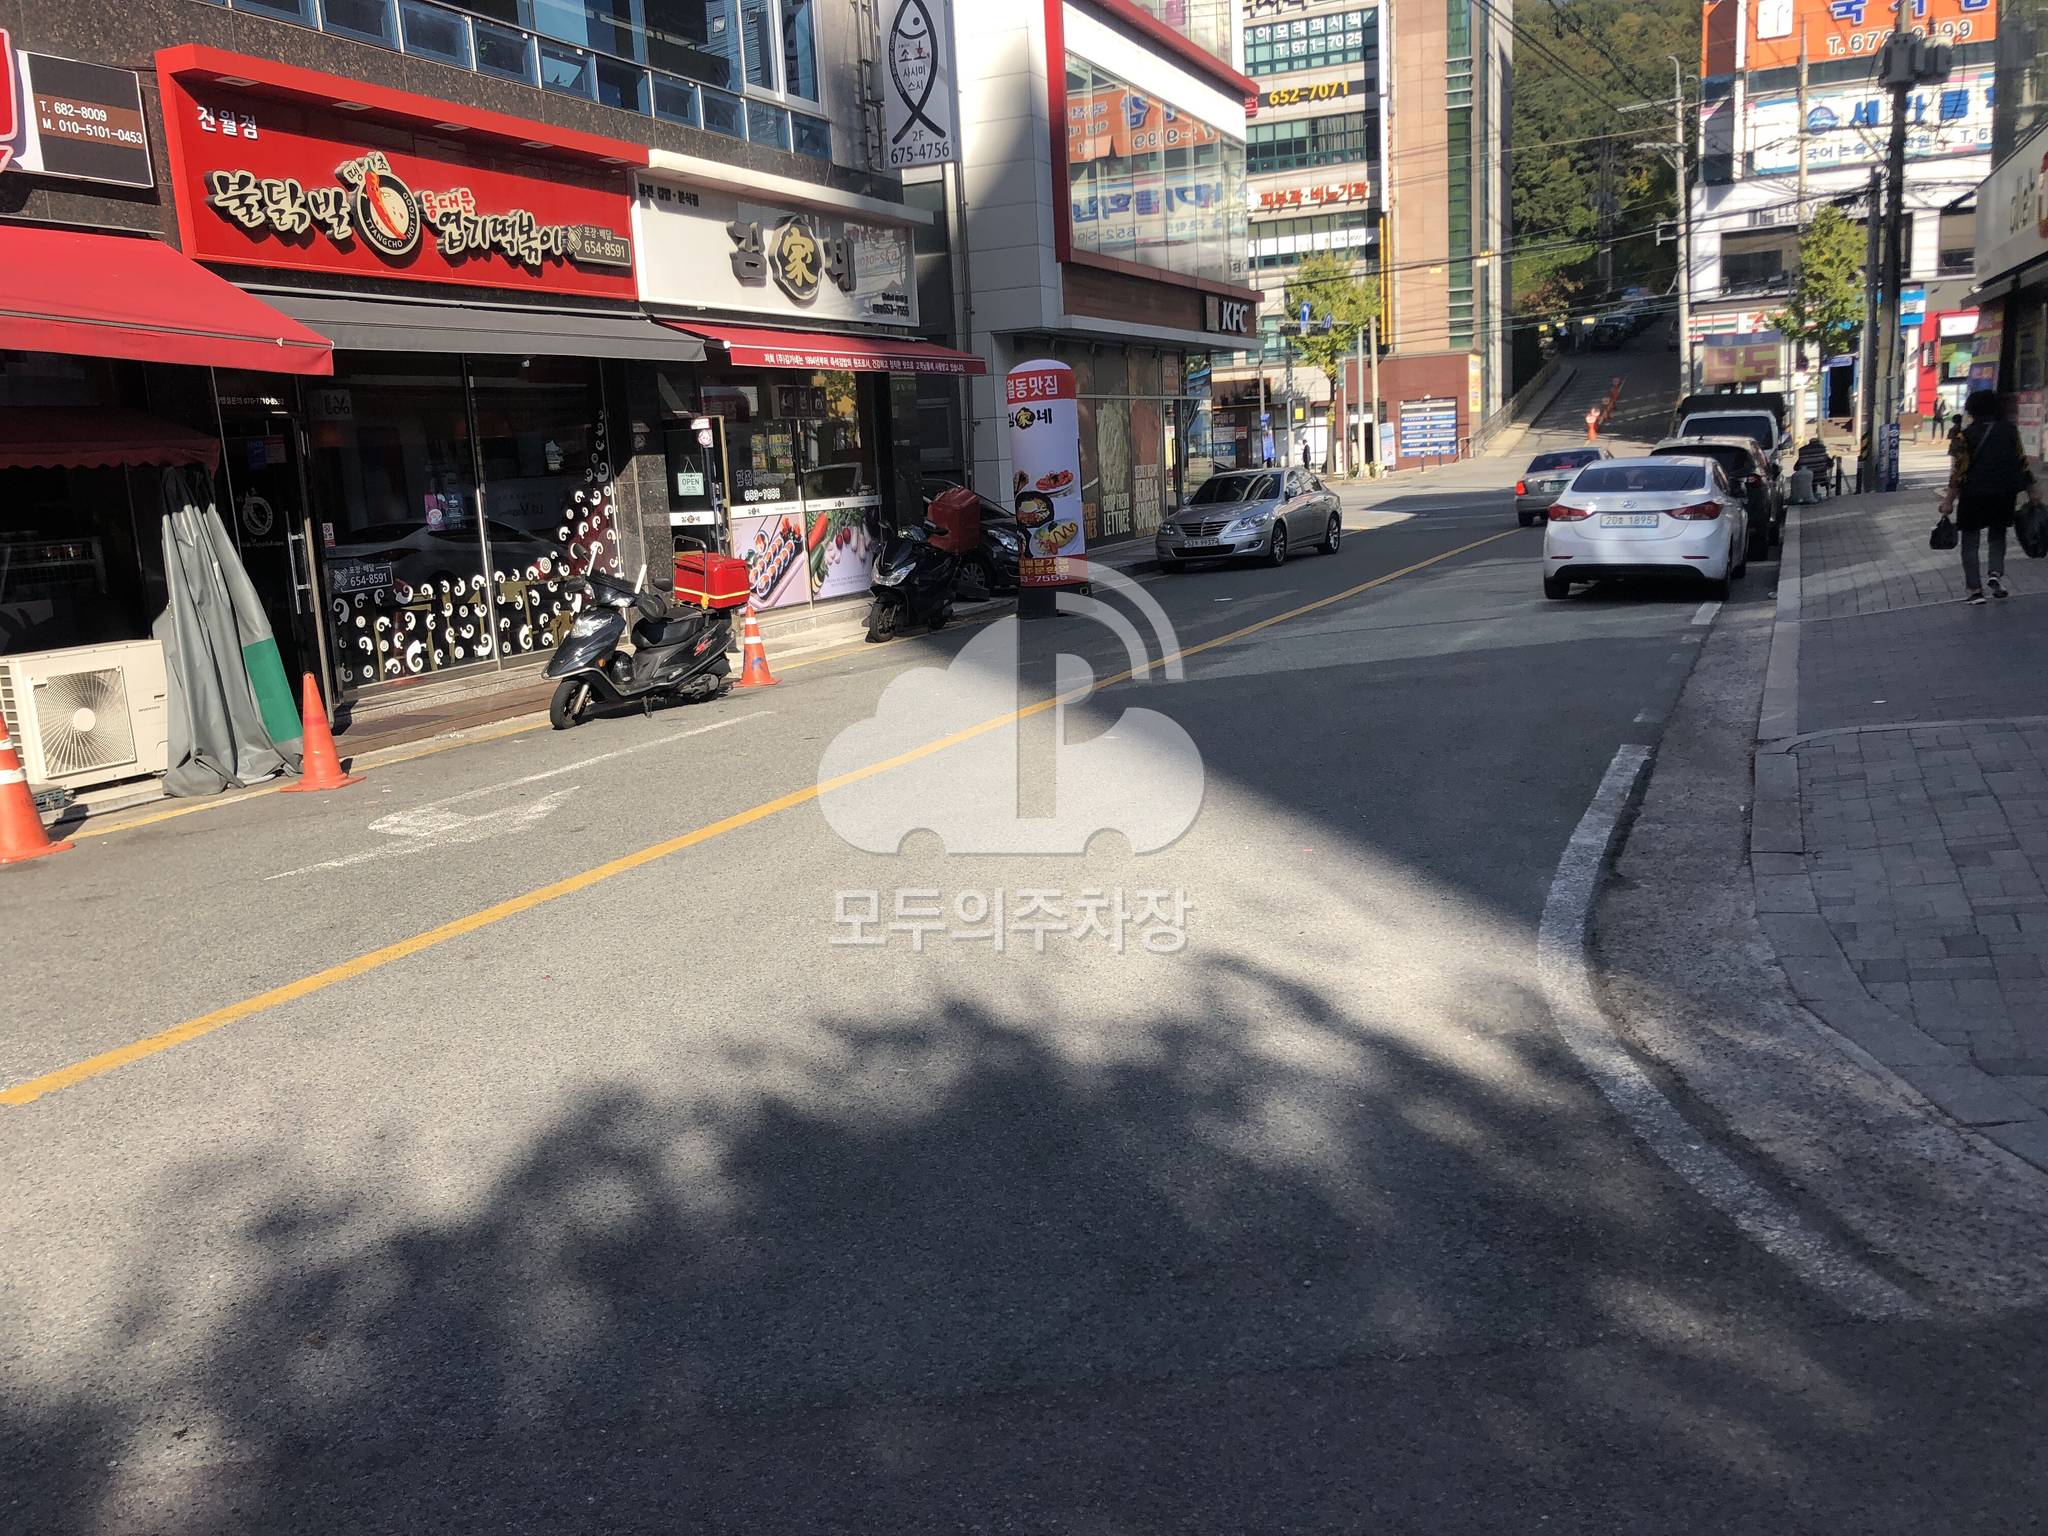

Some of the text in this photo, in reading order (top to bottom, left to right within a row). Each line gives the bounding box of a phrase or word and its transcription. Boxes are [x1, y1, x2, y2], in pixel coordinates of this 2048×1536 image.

[903, 64, 926, 79] 사시미
[908, 81, 924, 91] 스시
[1269, 81, 1349, 106] 652-7071
[40, 101, 107, 122] T. 682-8009
[43, 118, 143, 145] M. 010-5101-0453
[912, 130, 925, 142] 2F
[890, 142, 950, 164] 675-4756
[212, 170, 353, 241] 불닭발
[423, 190, 473, 219] 동대문
[366, 218, 403, 248] TTANGCHO
[439, 211, 562, 265] 엽기떡볶이
[584, 240, 625, 258] 654-8591
[1222, 301, 1248, 333] KFC
[682, 478, 700, 486] OPEN
[350, 574, 388, 587] 654-8591
